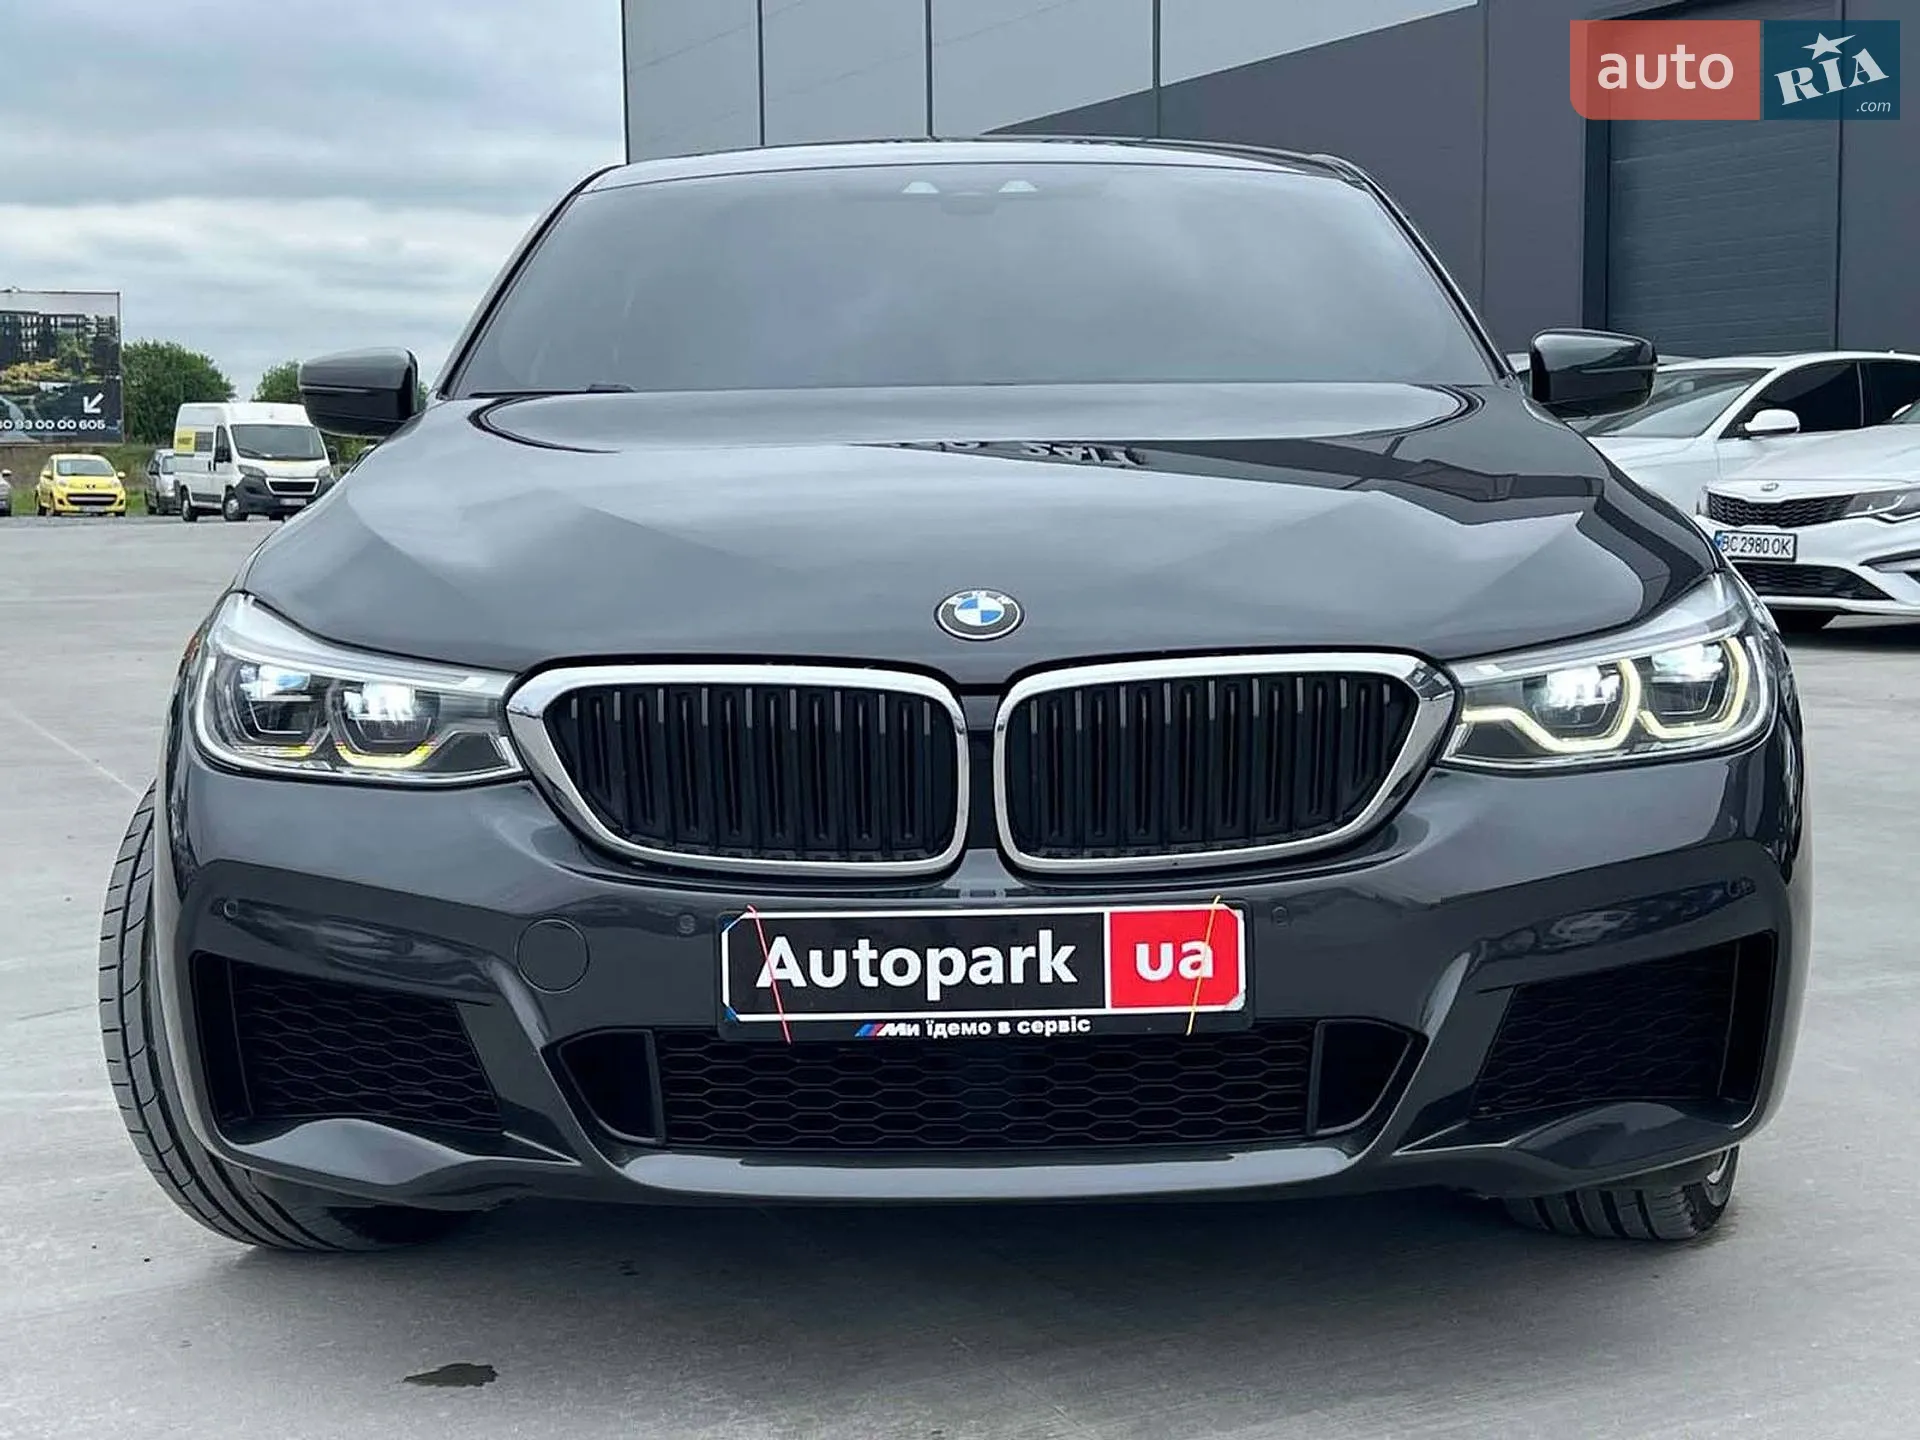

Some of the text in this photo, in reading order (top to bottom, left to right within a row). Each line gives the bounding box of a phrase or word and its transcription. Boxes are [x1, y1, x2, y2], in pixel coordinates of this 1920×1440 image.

[35, 419, 55, 430] 00
[57, 419, 77, 430] 00
[1740, 536, 1770, 554] 2980
[1772, 537, 1791, 556] OK
[755, 929, 1214, 1001] Autopark ua
[925, 1019, 992, 1039] їдемо
[998, 1021, 1011, 1035] в
[1017, 1016, 1091, 1036] сервіс
